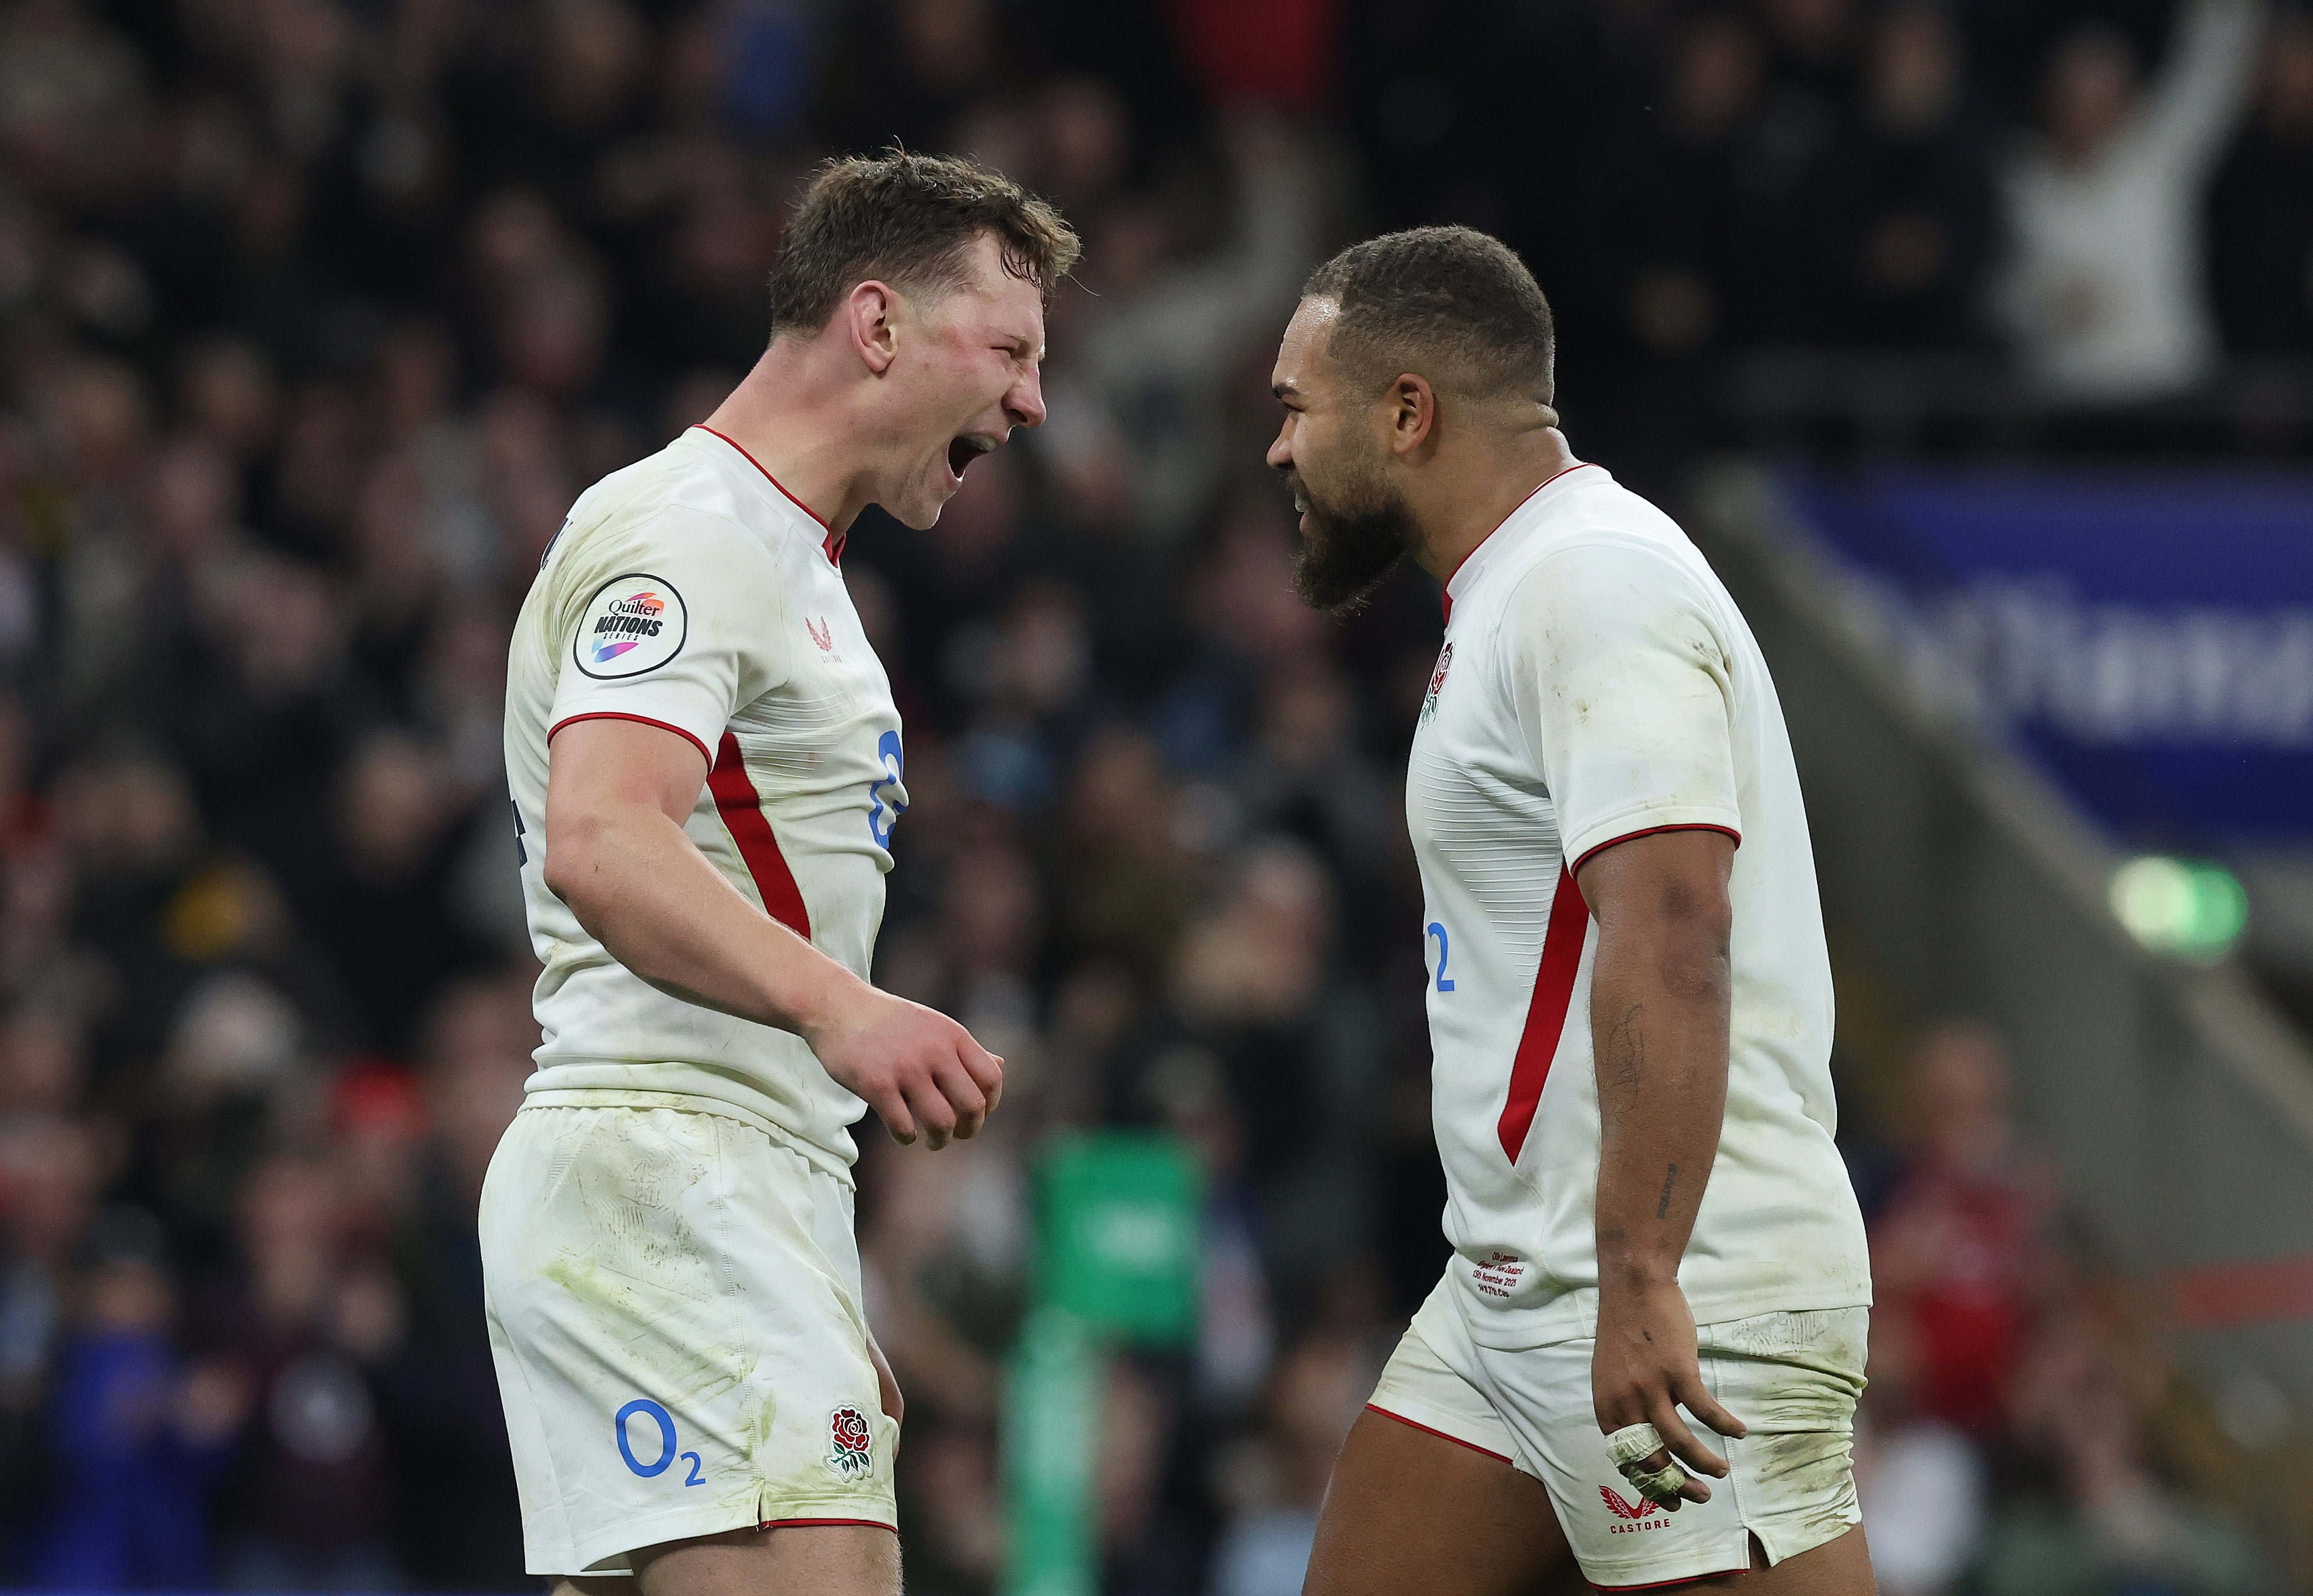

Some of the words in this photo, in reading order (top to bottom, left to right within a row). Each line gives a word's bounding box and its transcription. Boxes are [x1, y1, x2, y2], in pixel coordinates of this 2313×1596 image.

[609, 599, 659, 616] Quilter
[594, 616, 663, 637] NATIONS
[603, 633, 638, 641] SERIES
[1610, 1518, 1671, 1534] CASTORE
